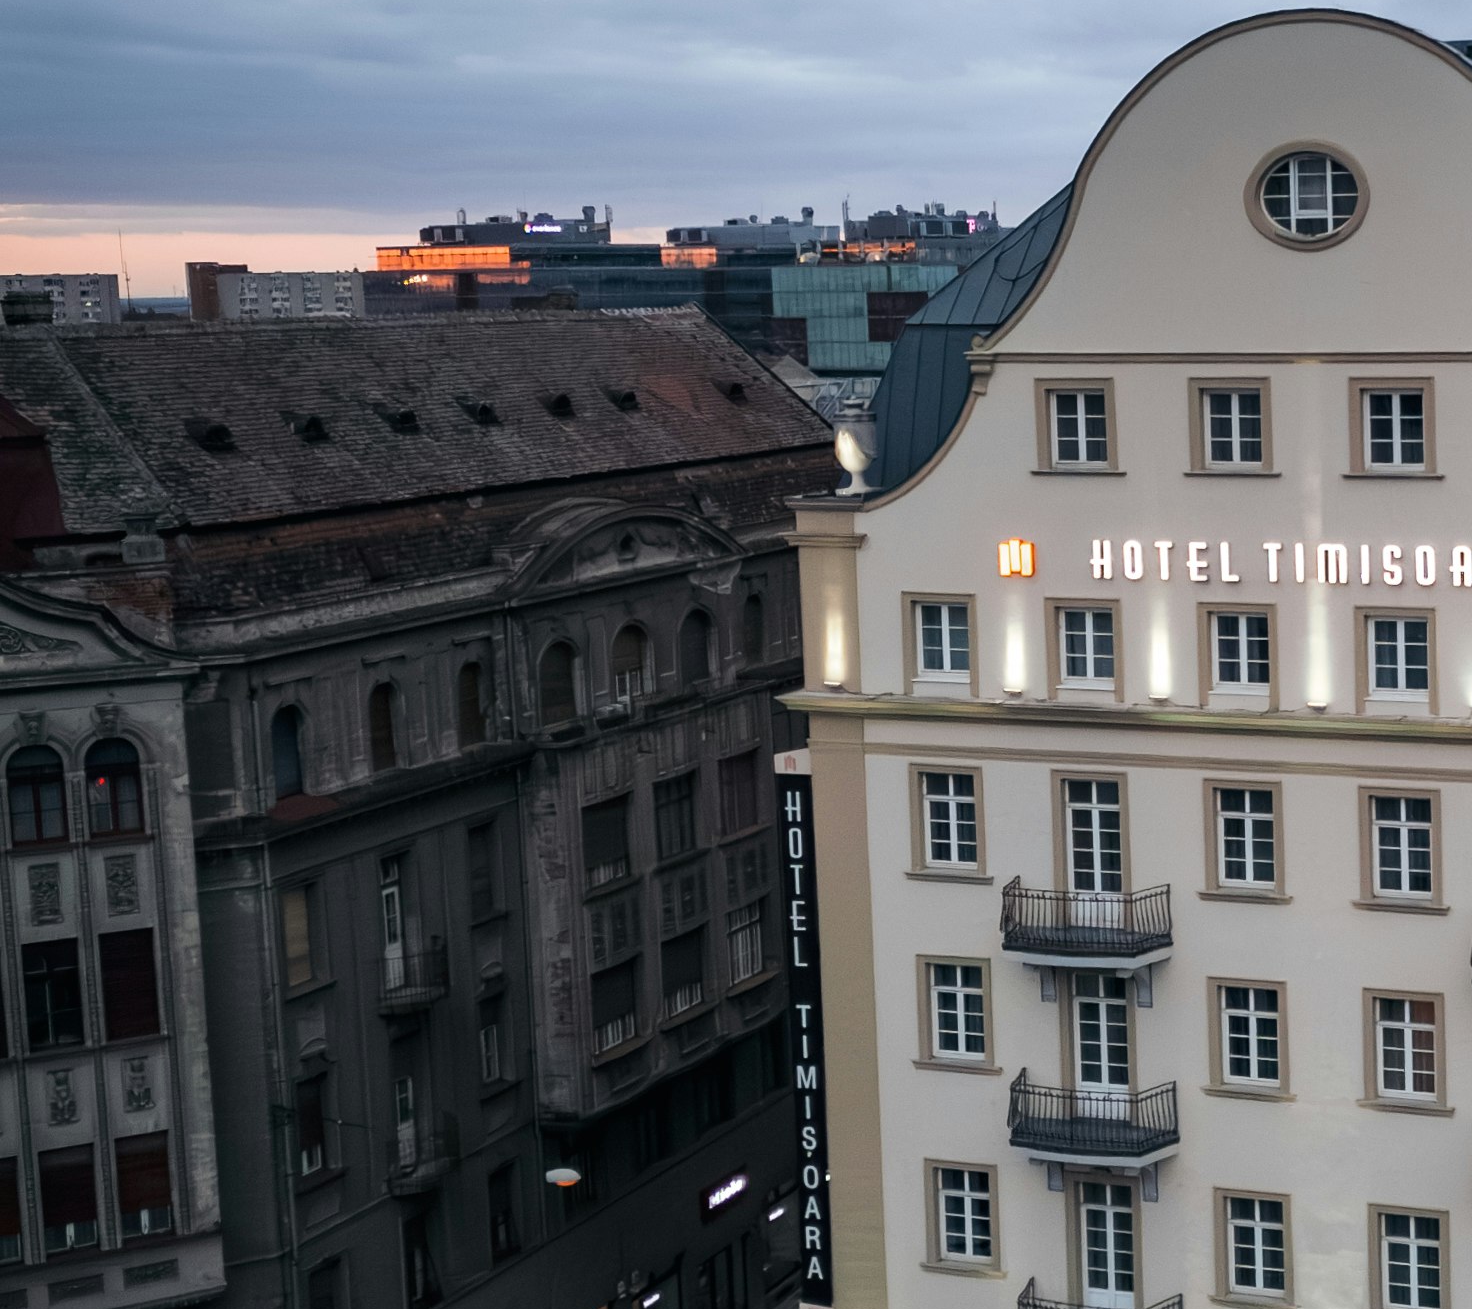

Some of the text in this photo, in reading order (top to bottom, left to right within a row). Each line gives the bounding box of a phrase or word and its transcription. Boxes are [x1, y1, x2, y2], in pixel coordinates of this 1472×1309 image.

[1090, 539, 1240, 582] HOTEL
[784, 790, 824, 1281] HOTEL TIMIȘOARA
